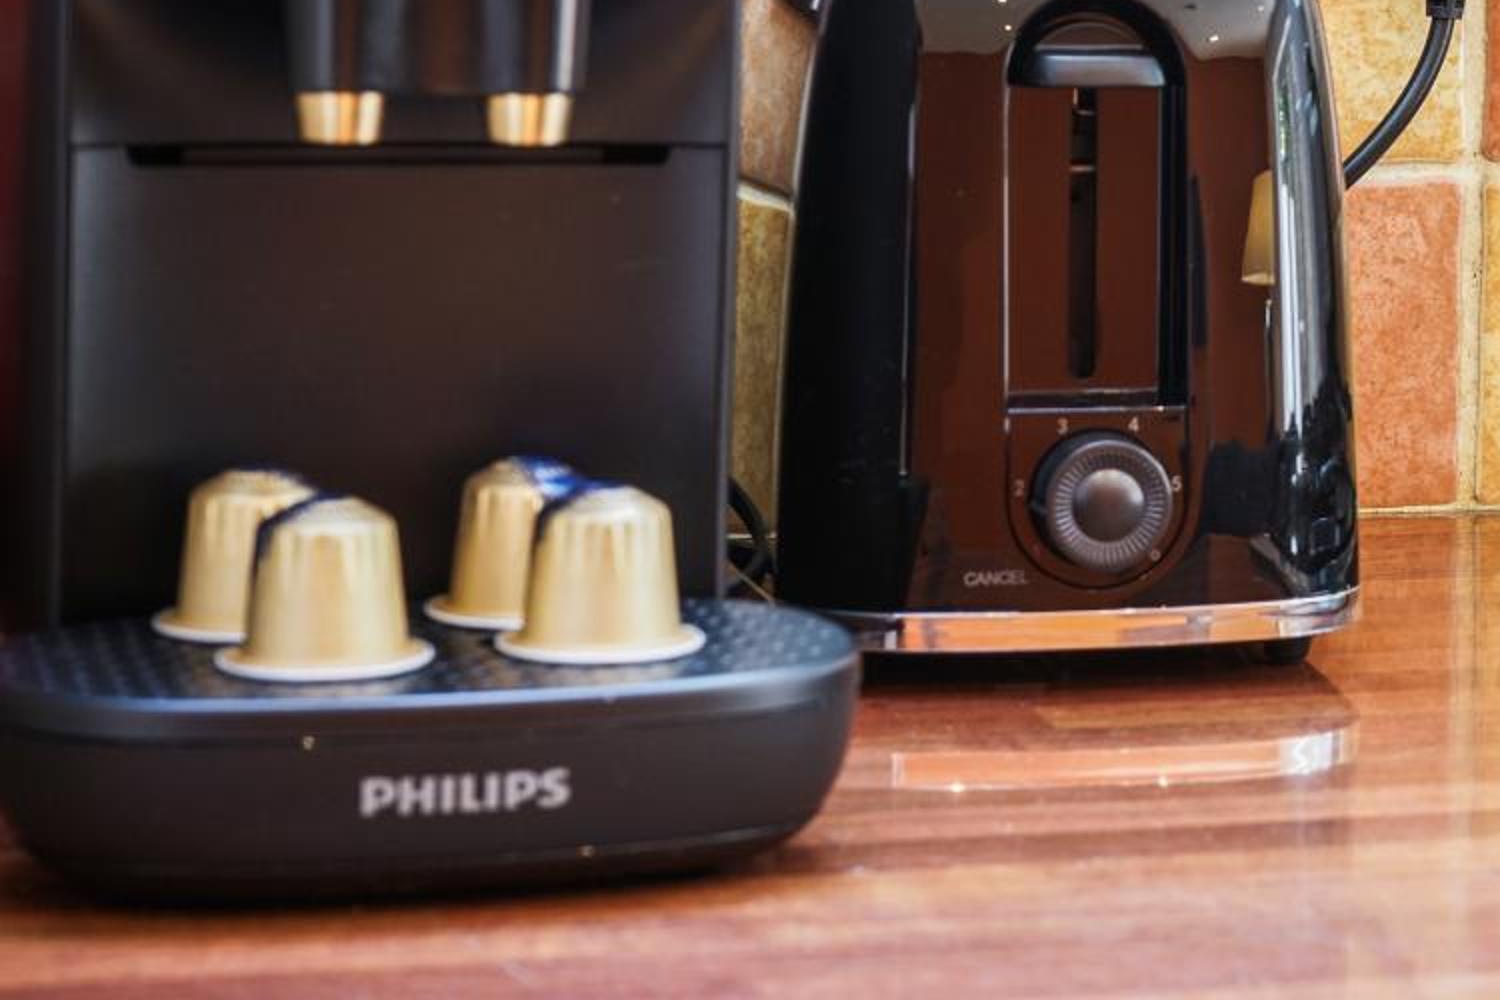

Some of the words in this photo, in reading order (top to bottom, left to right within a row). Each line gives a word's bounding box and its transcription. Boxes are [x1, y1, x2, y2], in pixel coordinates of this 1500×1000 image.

[1057, 417, 1069, 435] 3
[1128, 416, 1140, 432] 4
[1172, 475, 1183, 492] 5
[963, 570, 1030, 587] CANCEL
[360, 767, 572, 818] PHILIPS
